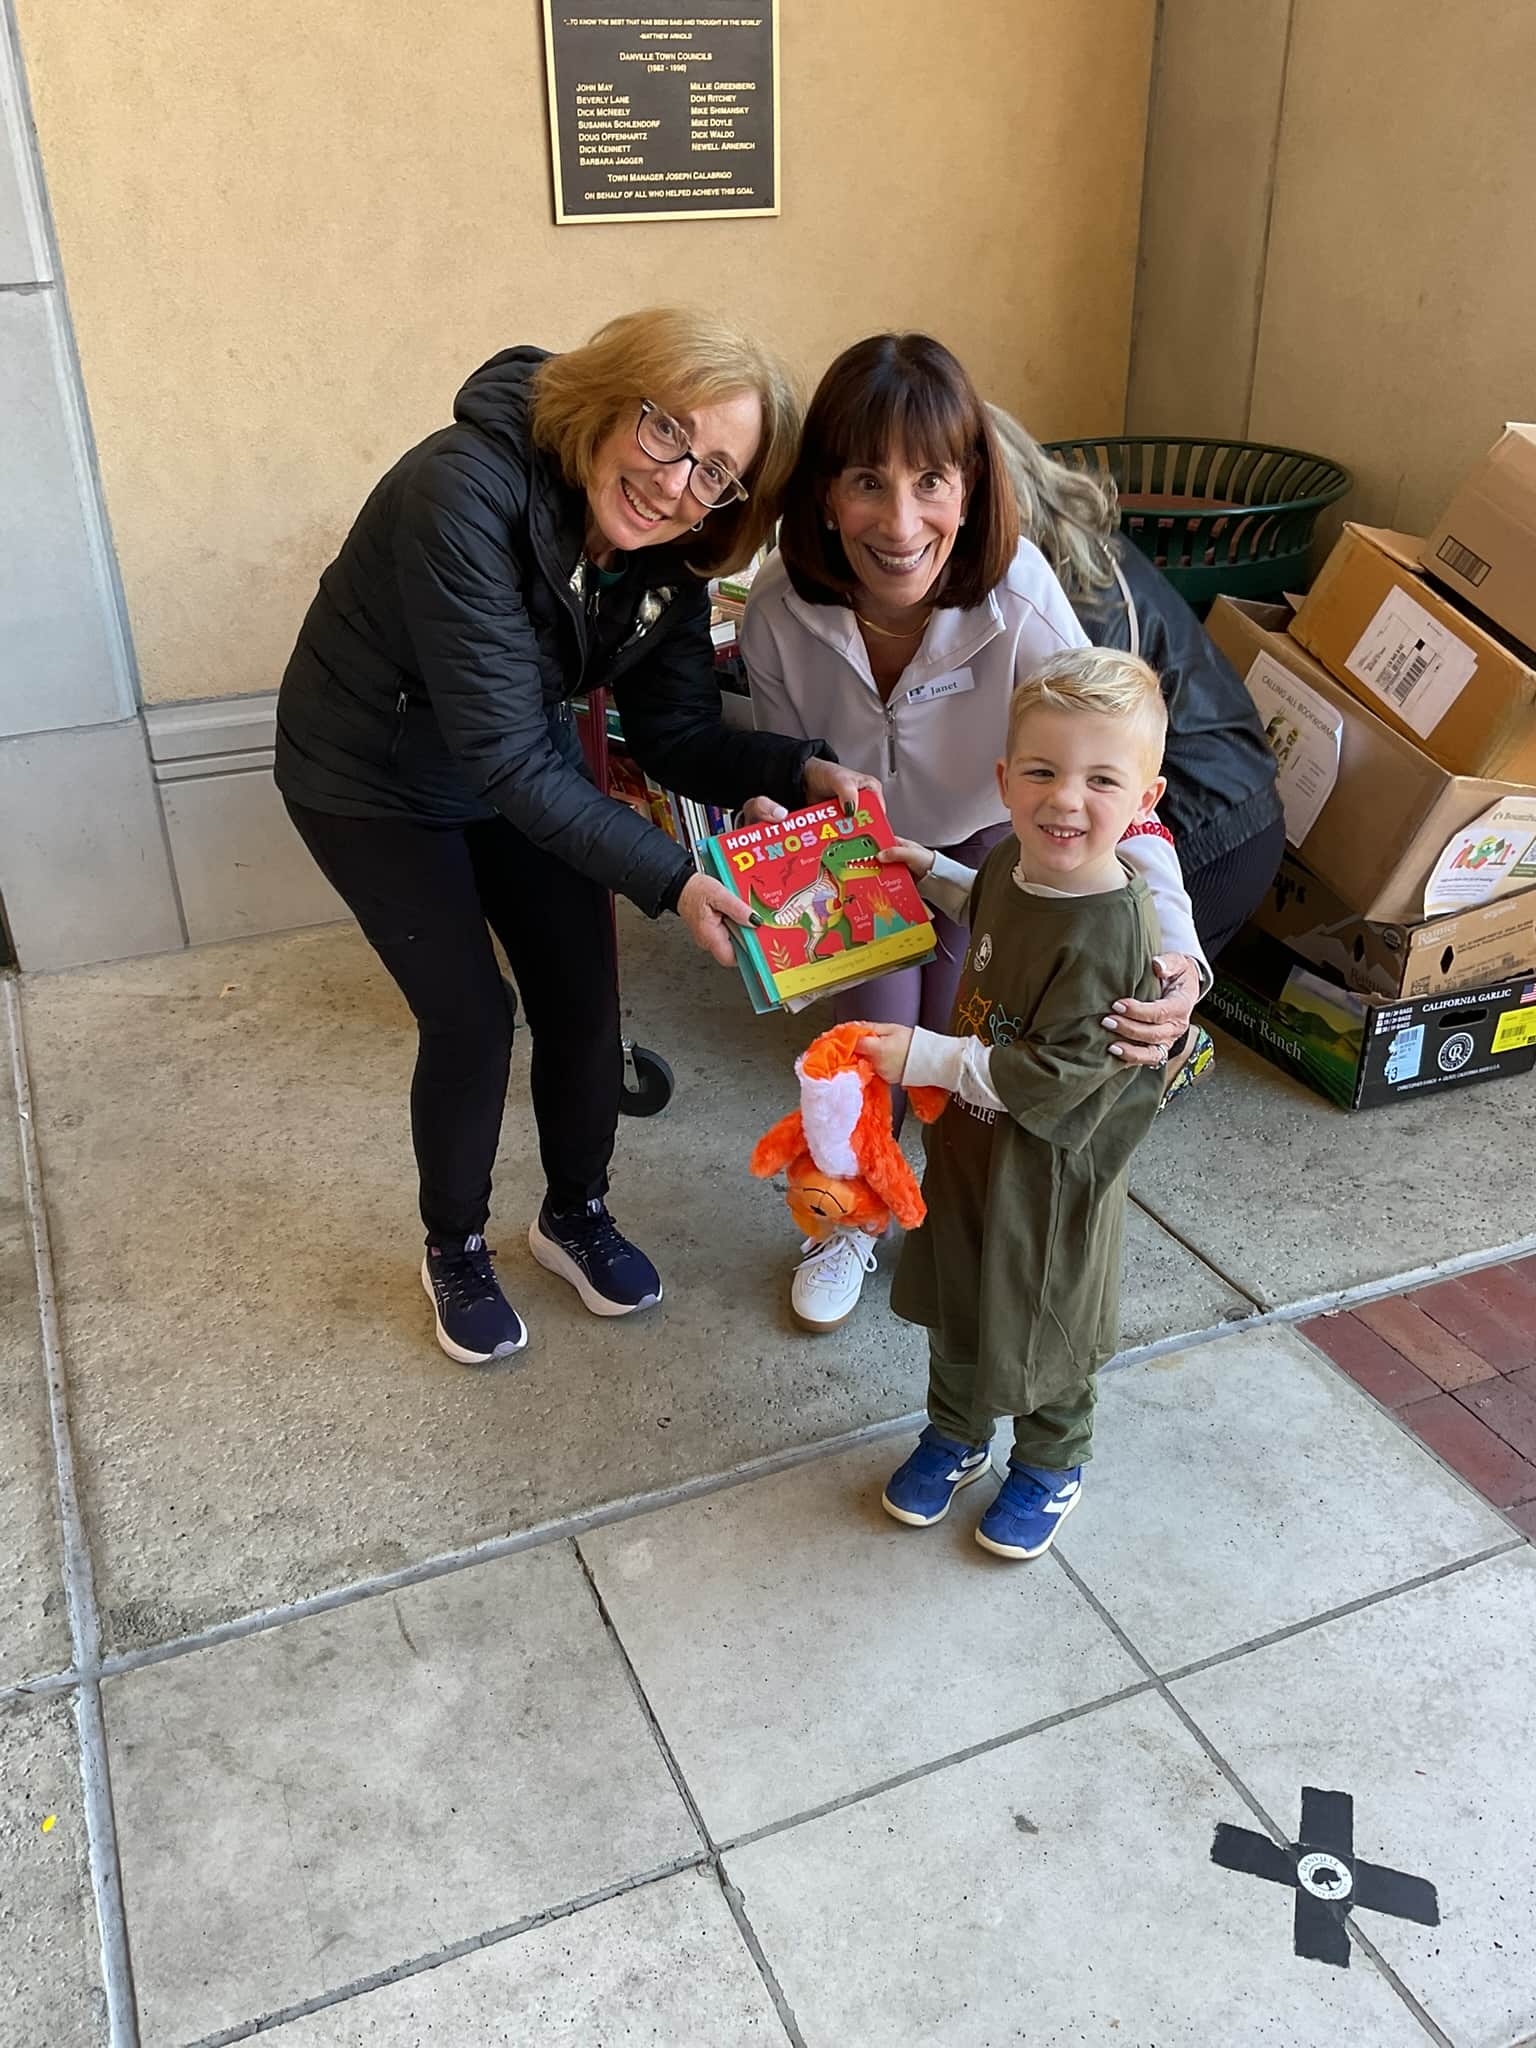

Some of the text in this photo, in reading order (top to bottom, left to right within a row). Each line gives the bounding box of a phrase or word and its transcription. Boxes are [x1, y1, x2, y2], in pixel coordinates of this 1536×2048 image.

[579, 18, 597, 26] KNOW
[598, 18, 609, 26] THE
[610, 18, 625, 26] BEST
[626, 18, 640, 26] THAT
[641, 18, 653, 26] HAS
[653, 18, 669, 26] BEEN
[669, 18, 683, 26] SAID
[683, 18, 696, 26] AND
[696, 18, 722, 26] THOUGHT
[722, 18, 729, 26] IN
[729, 18, 740, 26] THE
[669, 32, 693, 40] ARNOLD
[619, 51, 713, 61] DANVILLE TOWN COUNCILS
[575, 82, 614, 92] JOHN MAY
[689, 81, 756, 91] MILLIE GREENBERG
[576, 95, 631, 105] BEVERLY LANE
[690, 94, 737, 103] DON RITCHEY
[577, 107, 596, 117] DICK
[690, 106, 709, 115] MIKE
[578, 120, 613, 130] SUSANNA
[691, 118, 733, 127] MIKE DOYLE
[578, 132, 600, 142] DOUG
[691, 130, 735, 139] DICK WALDO
[579, 145, 598, 154] DICK
[691, 142, 720, 151] NEWELL
[579, 156, 644, 167] BARBARA JAGGER
[607, 171, 733, 183] TOWN MANAGER JOSEPH CALABRIGO
[584, 186, 755, 200] ON BEHALF OF ALL WHO HELPED ACHIEVE THIS GOAL
[930, 681, 958, 697] Janet
[1261, 675, 1287, 700] CALLING
[1286, 694, 1298, 707] ALL
[725, 805, 839, 851] HOW IT WORKS
[731, 809, 875, 873] DINOSAUR
[1422, 988, 1512, 1013] CALIFORNIA GARLIC
[1260, 1019, 1302, 1062] Ranch
[969, 1103, 996, 1124] Life
